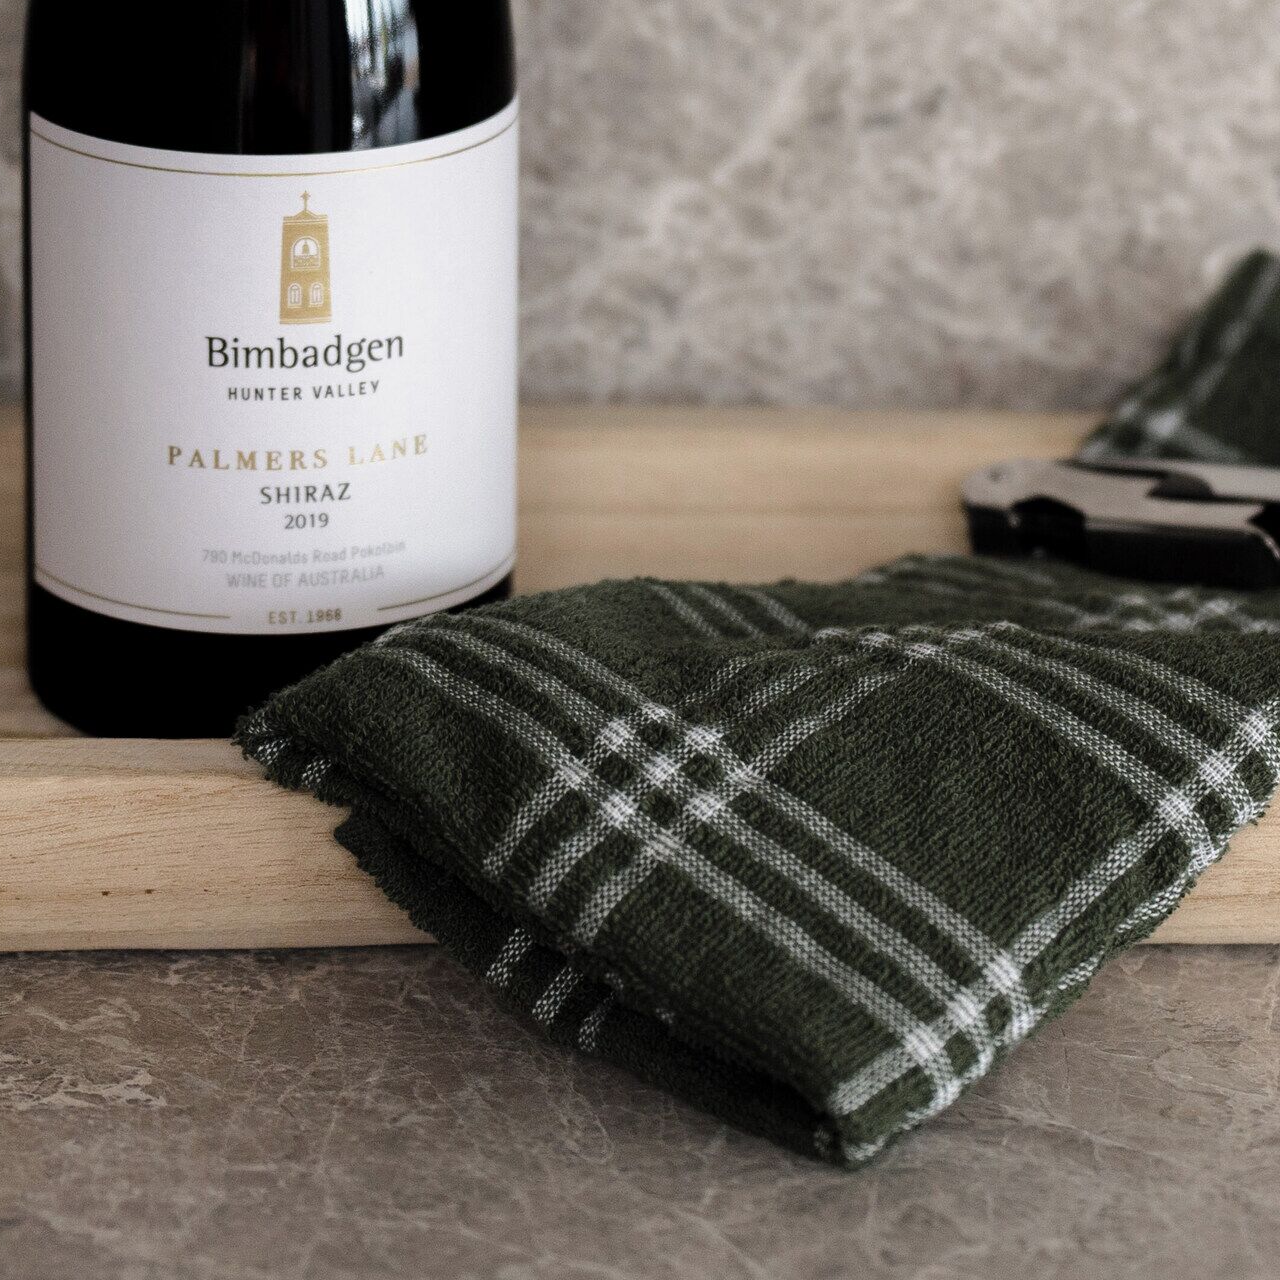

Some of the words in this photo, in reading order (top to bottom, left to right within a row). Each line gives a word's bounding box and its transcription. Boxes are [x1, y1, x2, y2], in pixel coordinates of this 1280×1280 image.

[205, 334, 404, 373] Bimbadgen
[228, 387, 303, 401] HUNTER
[312, 380, 381, 400] VALLEY
[167, 445, 329, 471] PALMERS
[348, 434, 428, 465] LANE
[260, 482, 352, 505] SHIRAZ
[284, 513, 330, 530] 2019
[232, 550, 308, 565] McDonalds
[312, 547, 347, 563] Road
[226, 573, 268, 588] WINE
[272, 573, 293, 588] OF
[298, 566, 385, 587] AUSTRALIA
